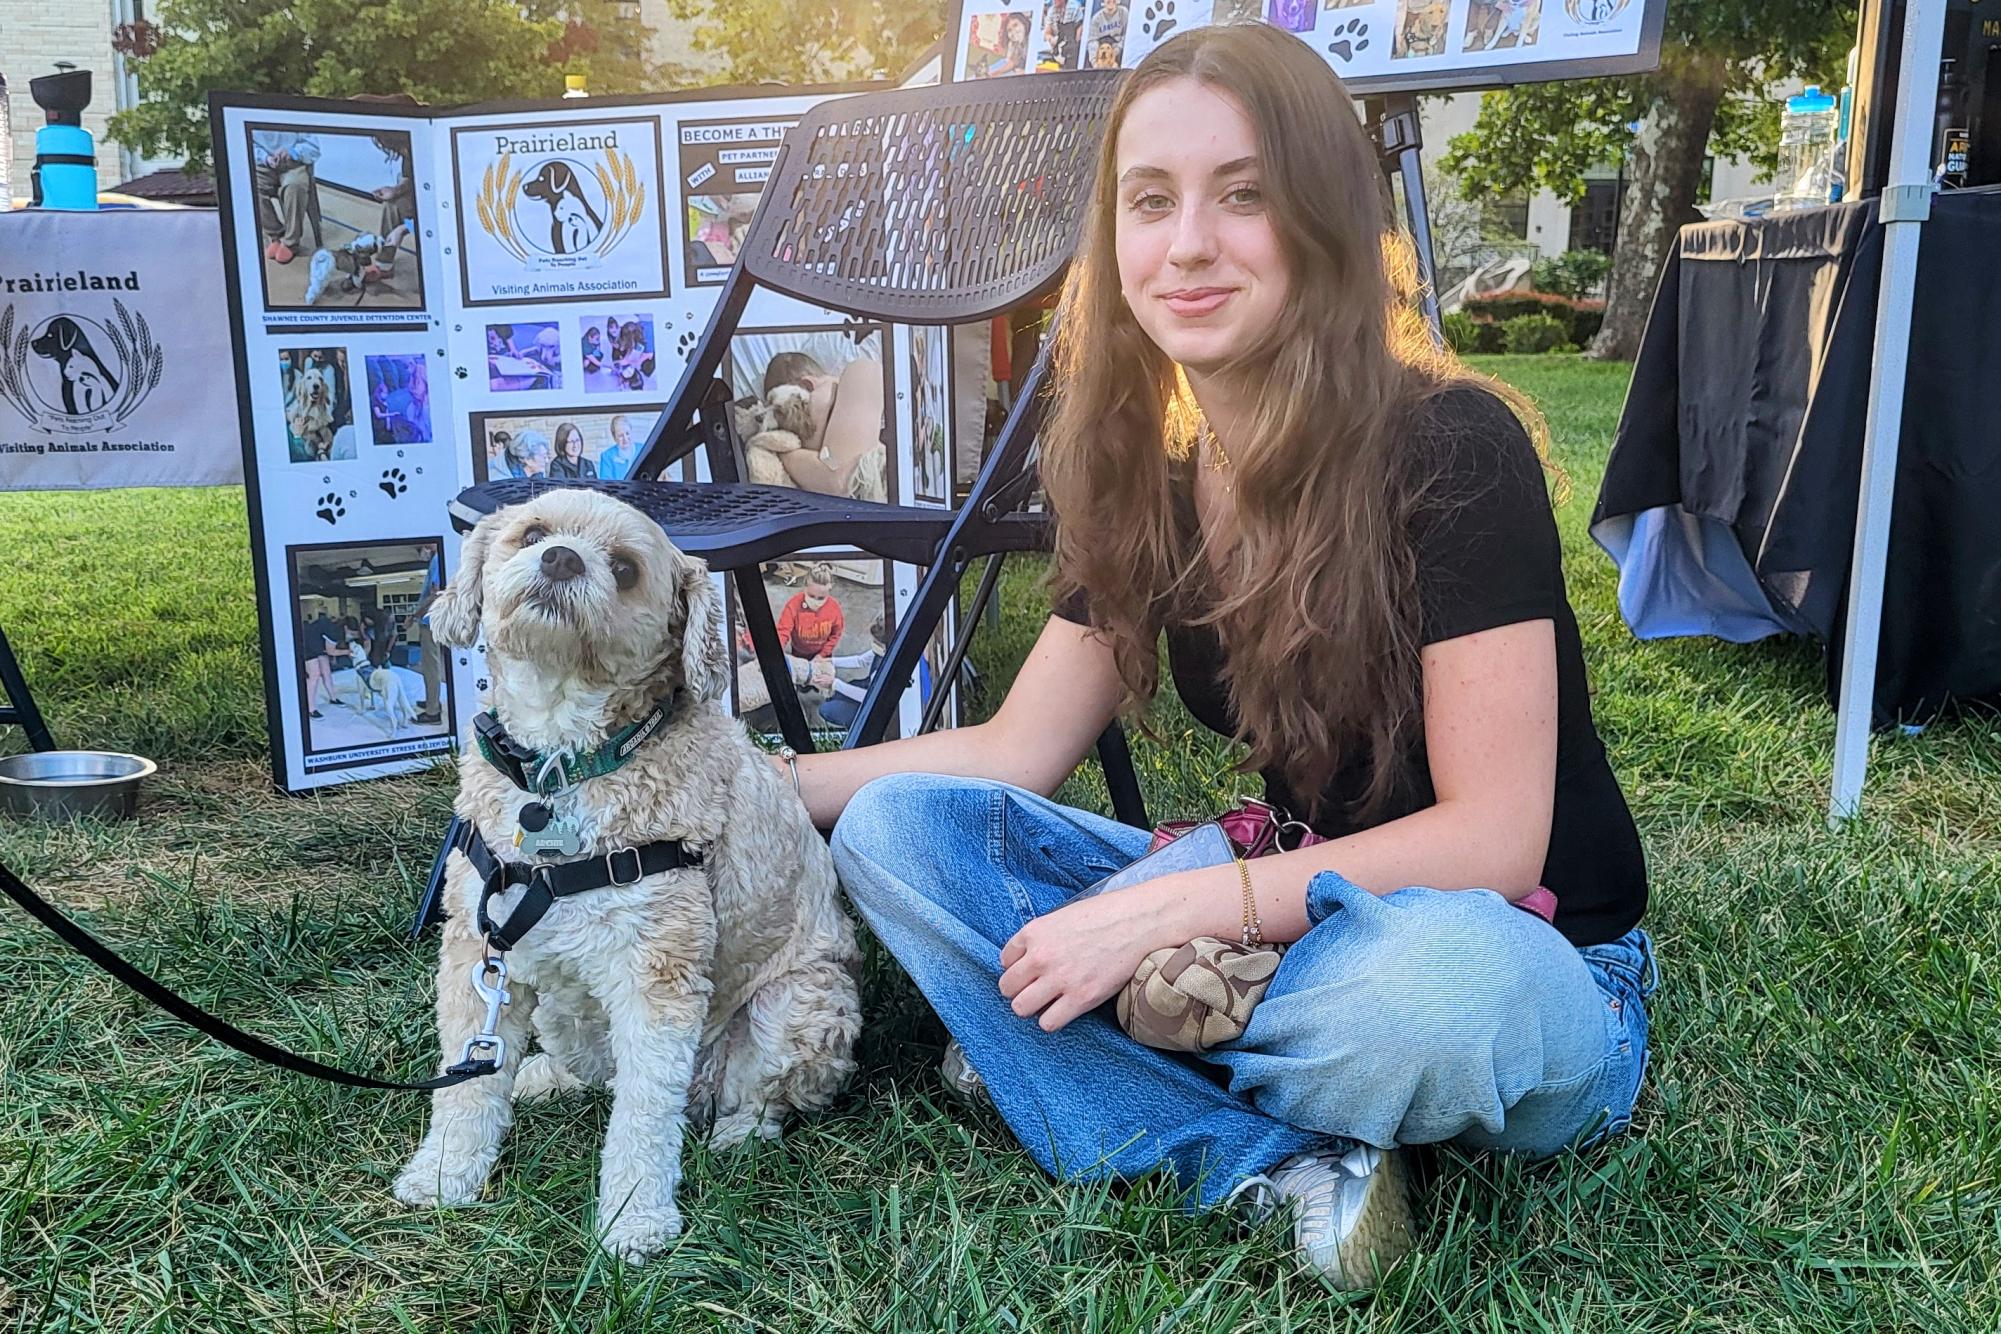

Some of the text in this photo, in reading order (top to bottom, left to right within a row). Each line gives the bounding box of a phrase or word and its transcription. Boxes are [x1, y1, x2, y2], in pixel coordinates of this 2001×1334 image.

[495, 130, 619, 155] Prairieland
[684, 128, 743, 142] BECOME
[748, 128, 758, 139] A
[690, 168, 712, 185] WITH
[738, 171, 769, 181] ALLIAN
[0, 271, 141, 293] rairieland
[492, 280, 638, 296] Visiting Animals Association
[262, 315, 298, 323] SHAWNEE
[330, 314, 364, 322] JUVENILE
[366, 314, 405, 322] DETENTION
[407, 313, 432, 321] CENTER
[0, 441, 175, 455] Visiting Animals Association
[307, 754, 348, 764] WASHBURN
[348, 748, 390, 759] UNIVERSITY
[392, 745, 416, 754] STRESS
